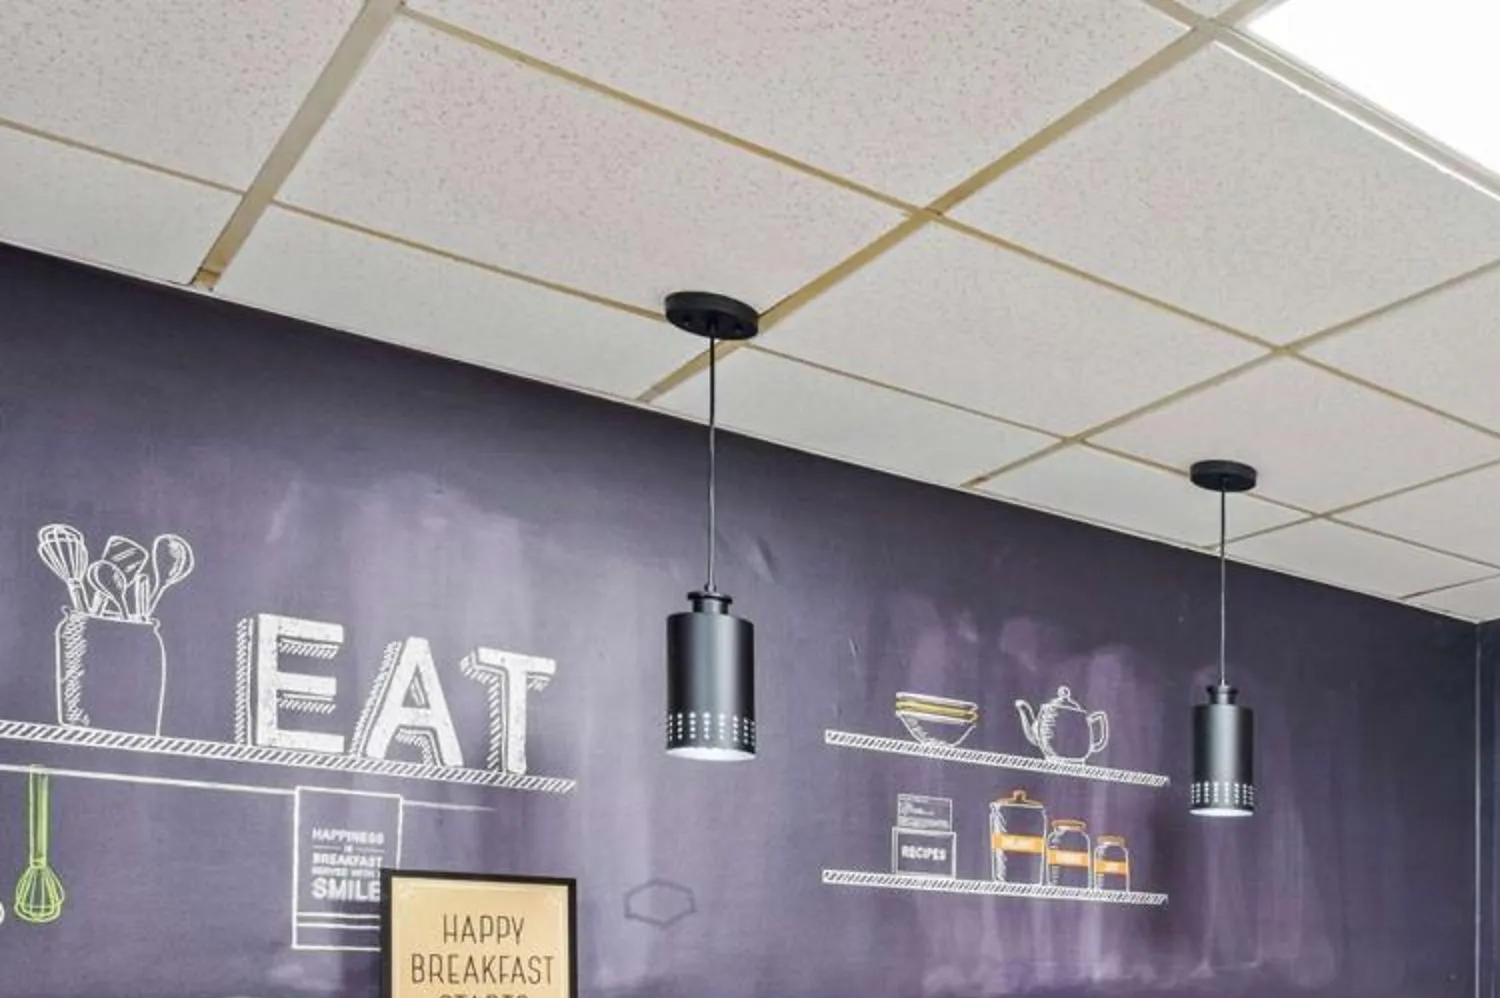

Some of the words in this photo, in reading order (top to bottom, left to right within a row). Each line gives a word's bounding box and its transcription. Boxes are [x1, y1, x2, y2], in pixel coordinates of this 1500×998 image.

[235, 613, 557, 776] EAT
[312, 827, 384, 845] HAPPINESS
[312, 852, 382, 868] BREAKFAST
[311, 877, 381, 902] SMILE
[443, 913, 525, 945] HAPPY
[411, 953, 555, 985] BREAKFAST
